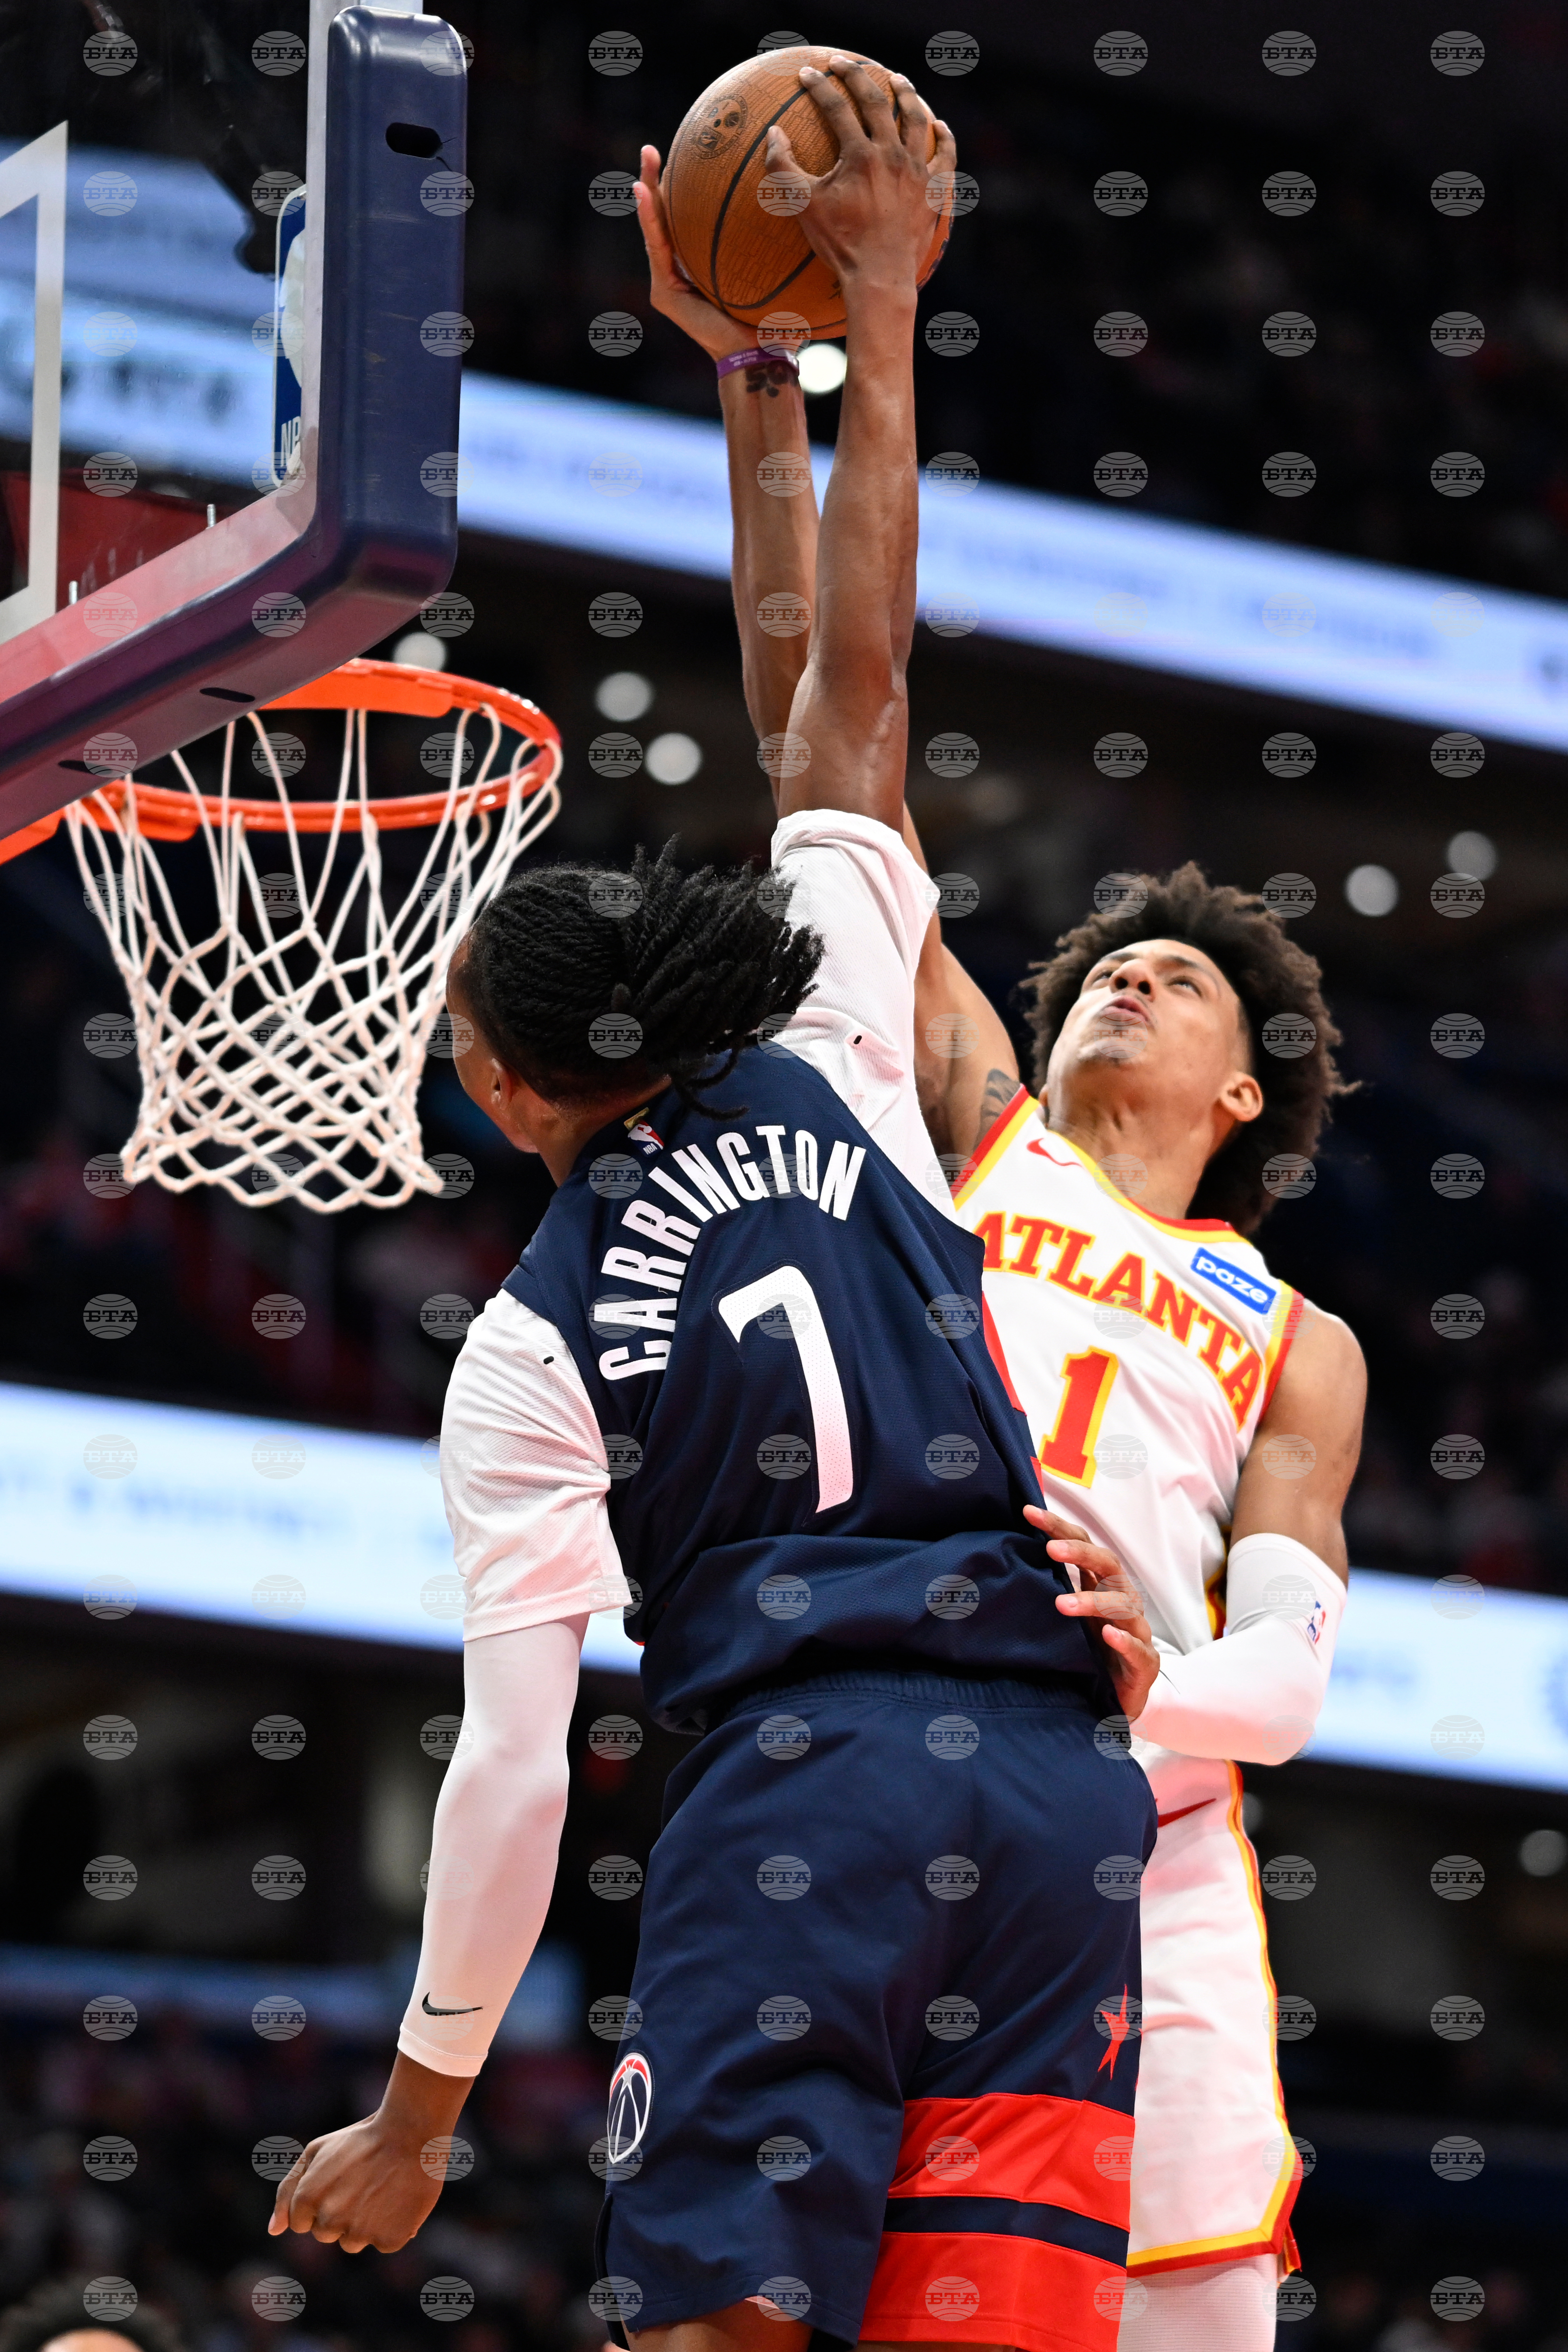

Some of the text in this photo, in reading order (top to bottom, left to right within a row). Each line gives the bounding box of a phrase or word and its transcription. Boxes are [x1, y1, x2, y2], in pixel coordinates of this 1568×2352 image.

[643, 1143, 657, 1155] NBA
[594, 1125, 866, 1380] CARRINGTON
[973, 1211, 1263, 1433] ATLANTA
[1196, 1256, 1268, 1303] paze
[718, 1265, 854, 1513] 7
[1038, 1345, 1119, 1488] 1
